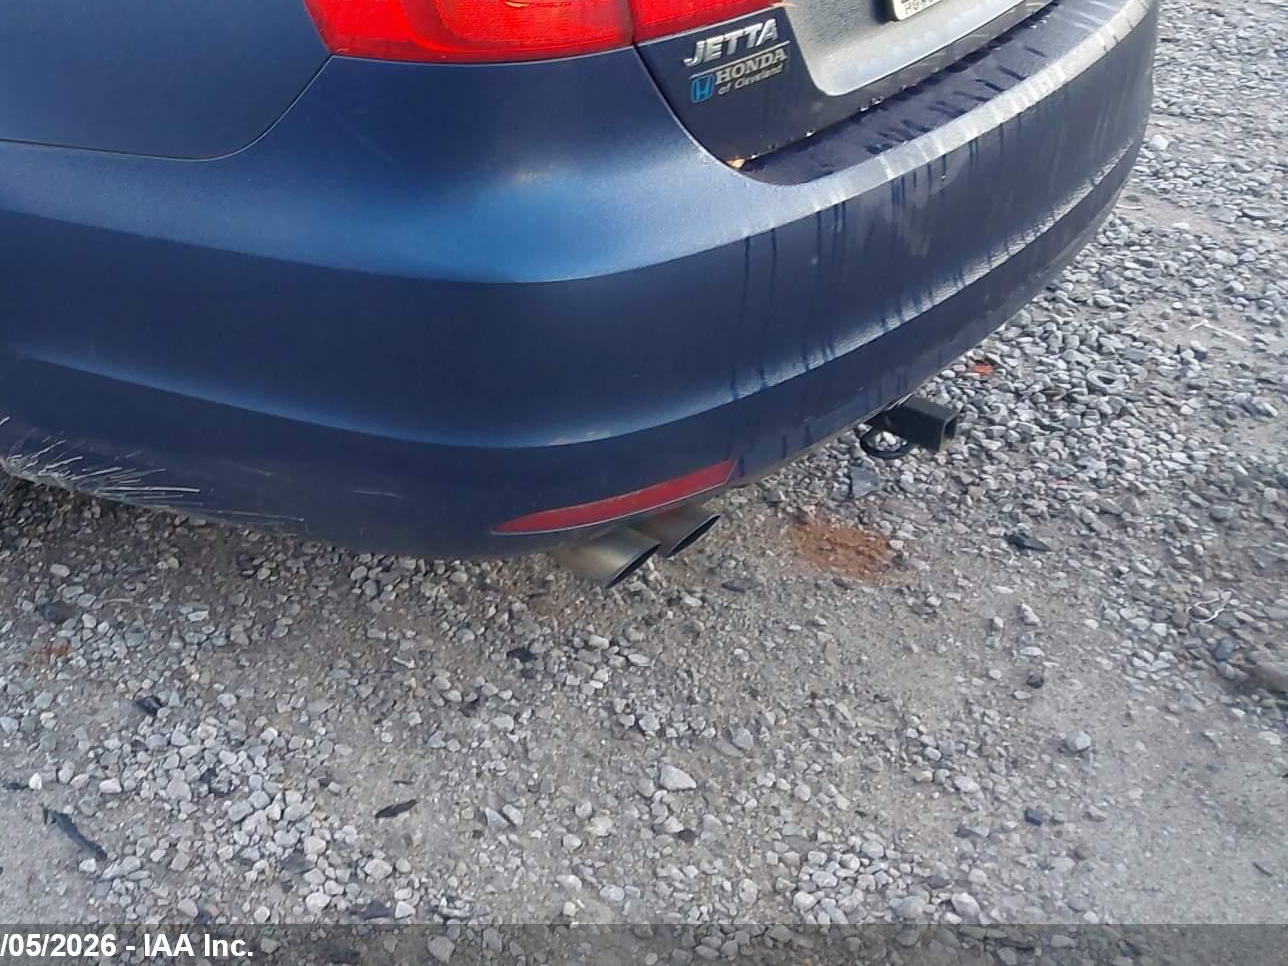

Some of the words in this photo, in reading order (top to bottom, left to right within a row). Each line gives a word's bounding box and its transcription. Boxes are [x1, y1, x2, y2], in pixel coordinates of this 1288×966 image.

[683, 18, 779, 67] JETTA
[715, 48, 788, 86] HONDA
[734, 62, 785, 90] Cleveland
